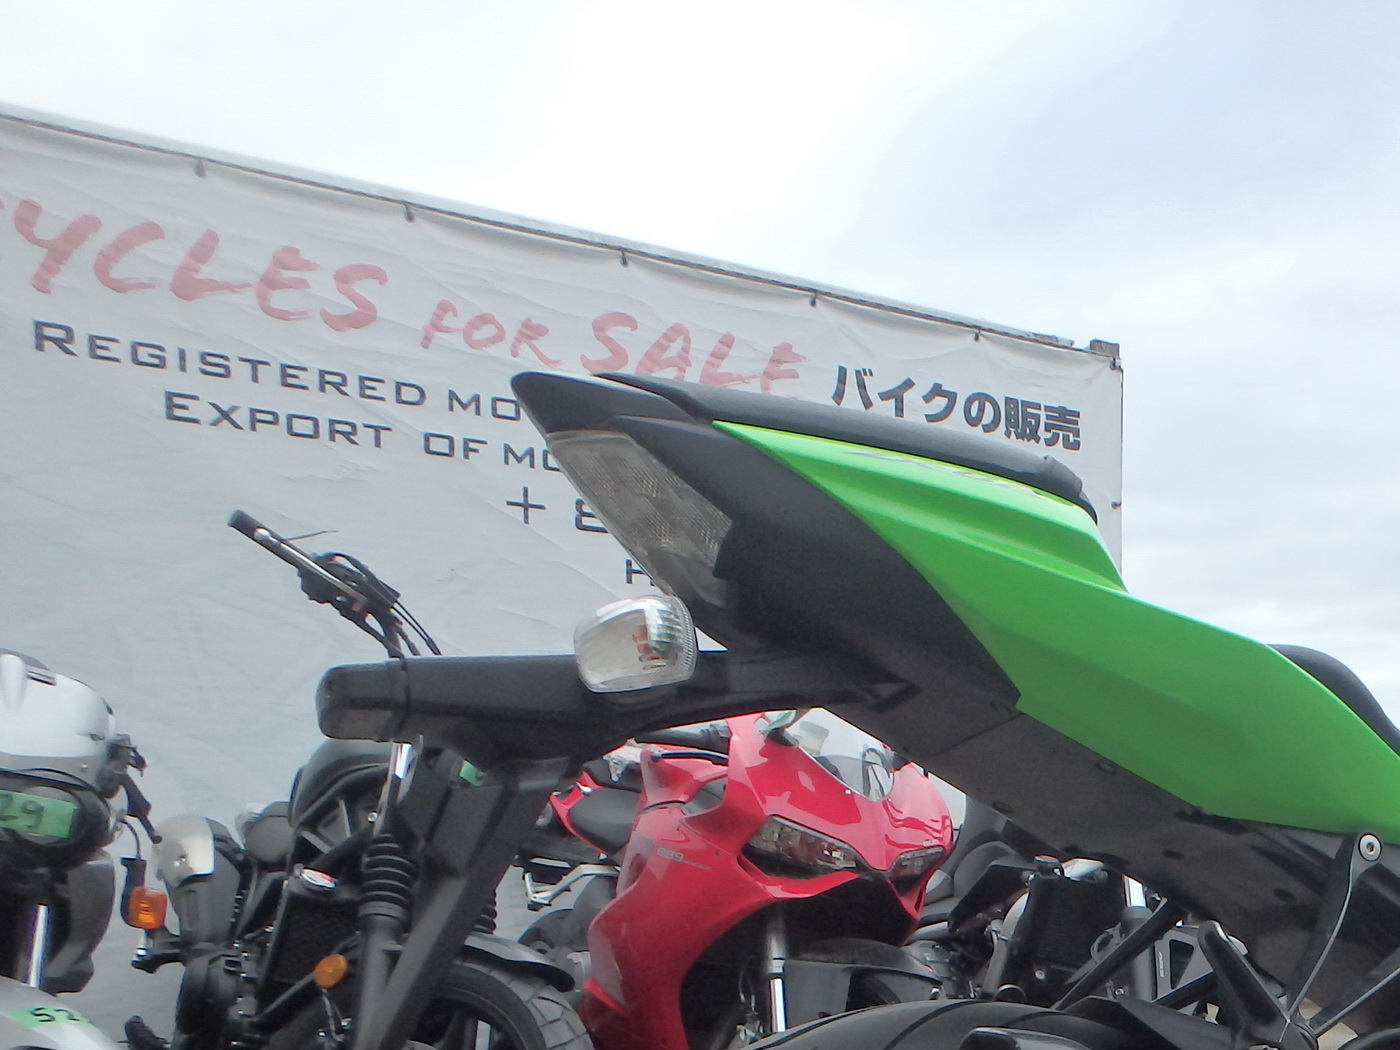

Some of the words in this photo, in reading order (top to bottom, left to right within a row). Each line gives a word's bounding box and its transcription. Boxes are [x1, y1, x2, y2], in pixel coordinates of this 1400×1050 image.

[33, 319, 427, 406] REGISTERED
[420, 299, 563, 367] FOR
[164, 390, 393, 448] EXPORT
[424, 432, 488, 460] OF
[831, 365, 1081, 451] バイクの販売
